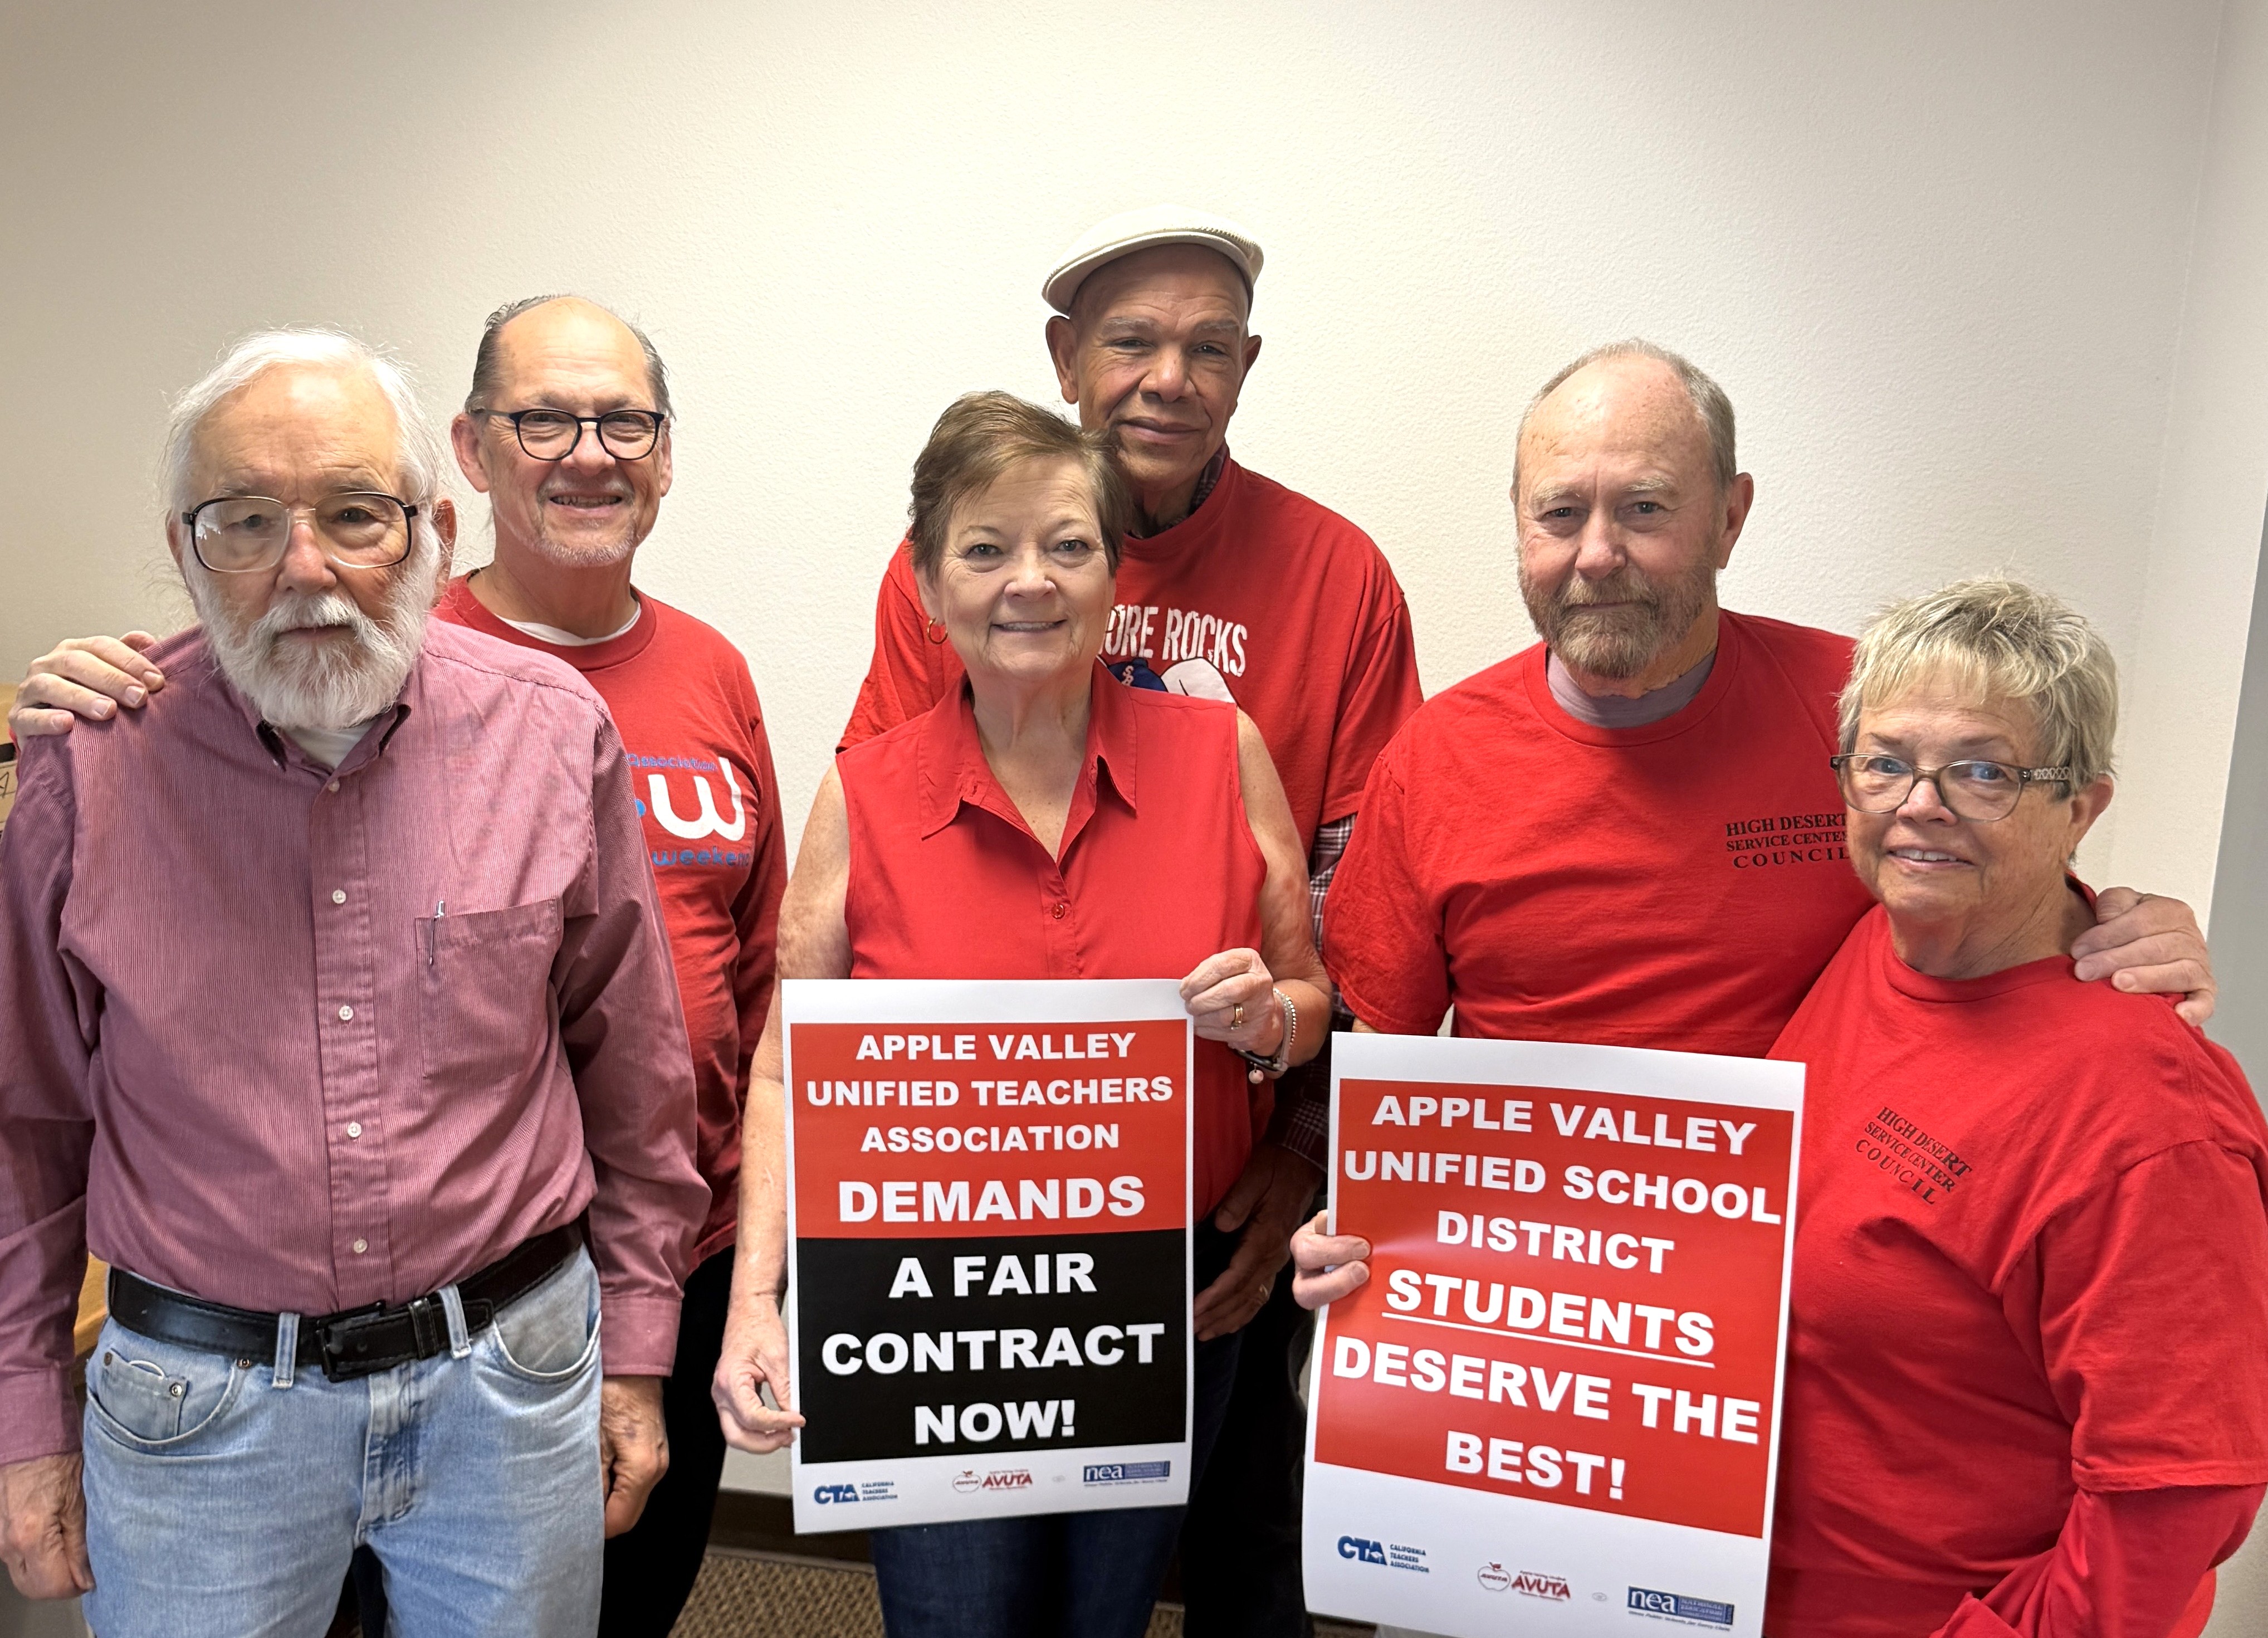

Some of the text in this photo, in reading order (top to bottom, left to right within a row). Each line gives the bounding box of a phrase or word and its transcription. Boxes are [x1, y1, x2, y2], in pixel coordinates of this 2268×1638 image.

[1100, 604, 1248, 677] ORE ROCKS
[1726, 813, 1847, 836] HIGH DESERT
[1727, 835, 1790, 852] SERVICE
[1733, 847, 1850, 869] COUNCIL
[856, 1032, 1136, 1060] APPLE VALLEY
[807, 1076, 1172, 1106] UNIFIED TEACHERS
[861, 1124, 1118, 1152] ASSOCIATION
[1372, 1096, 1757, 1155] APPLE VALLEY
[1876, 1106, 1973, 1177] HIGH DESERT
[1856, 1139, 1935, 1205] COUNCIL
[1864, 1122, 1956, 1192] SERVICE CENTER
[839, 1176, 1145, 1222] DEMANDS
[1345, 1150, 1781, 1225] UNIFIED SCHOOL
[1436, 1211, 1674, 1274] DISTRICT
[888, 1253, 1097, 1298] A FAIR
[1386, 1269, 1715, 1356] STUDENTS
[822, 1323, 1165, 1376] CONTRACT
[1333, 1336, 1760, 1444] DESERVE THE
[915, 1400, 1075, 1445] NOW!
[982, 1473, 1033, 1488] AVUTA
[1086, 1465, 1123, 1480] nea
[1445, 1430, 1626, 1500] BEST!
[814, 1484, 861, 1504] CTA
[1338, 1535, 1387, 1566] CTA
[1511, 1574, 1571, 1599] AVUTA
[1630, 1591, 1676, 1613] nea
